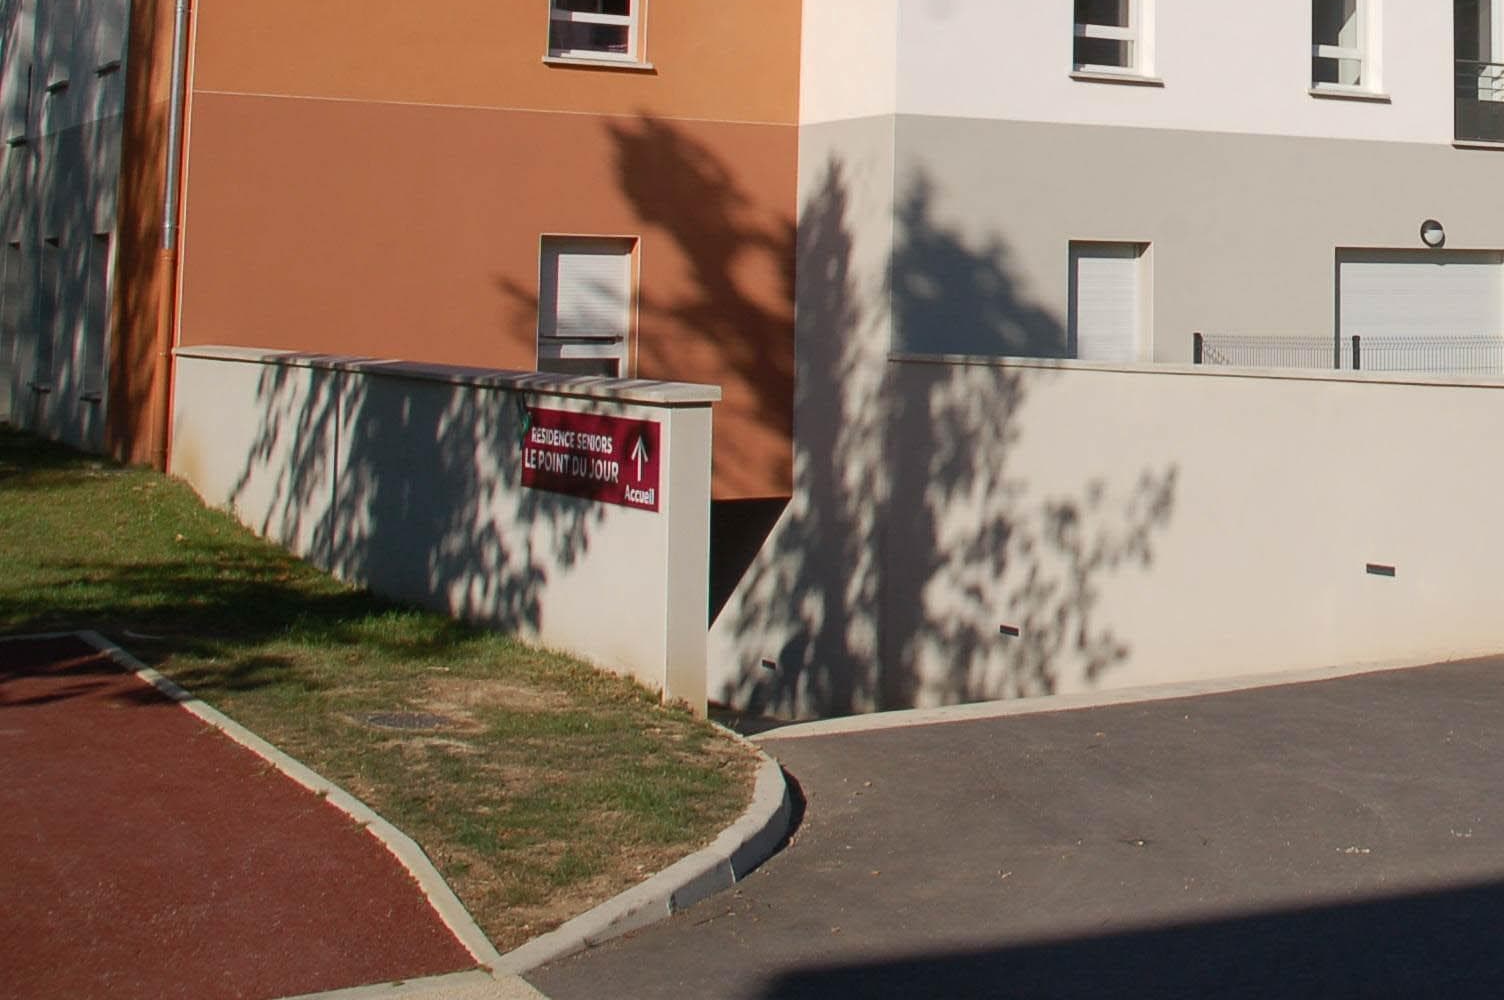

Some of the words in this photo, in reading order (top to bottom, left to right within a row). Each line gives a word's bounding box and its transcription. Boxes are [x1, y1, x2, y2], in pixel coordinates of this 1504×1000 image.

[531, 427, 575, 449] RESIDENCE
[577, 432, 613, 454] SENIORS
[524, 448, 536, 469] LE
[538, 451, 569, 474] POINT
[572, 456, 587, 478] DU
[589, 460, 619, 483] JOUR
[624, 484, 655, 505] Accueil
